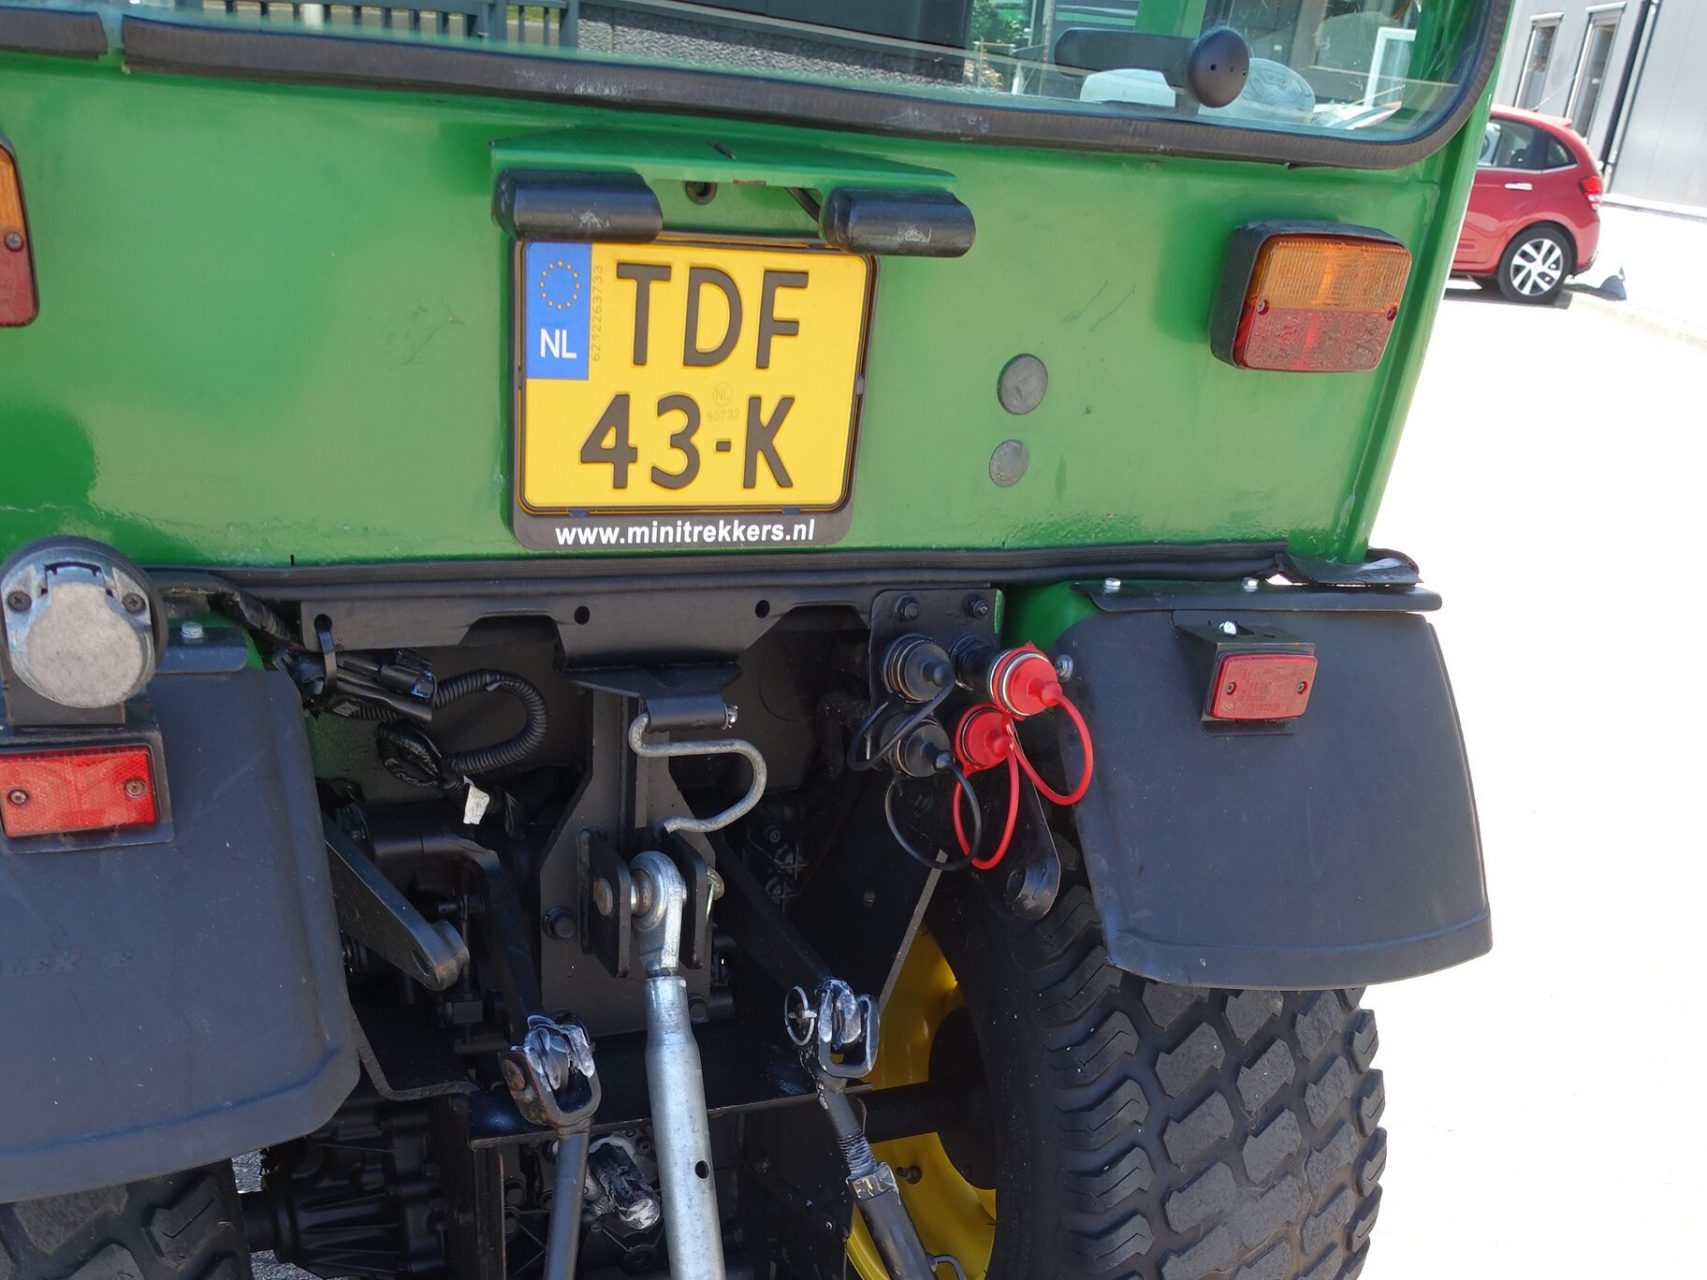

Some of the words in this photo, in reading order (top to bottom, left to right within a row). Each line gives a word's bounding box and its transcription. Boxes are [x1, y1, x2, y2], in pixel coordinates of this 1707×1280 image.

[540, 328, 577, 359] NL
[616, 262, 809, 369] TDF
[580, 394, 796, 490] 43-K
[555, 519, 815, 546] www.minitrekkers.nl
